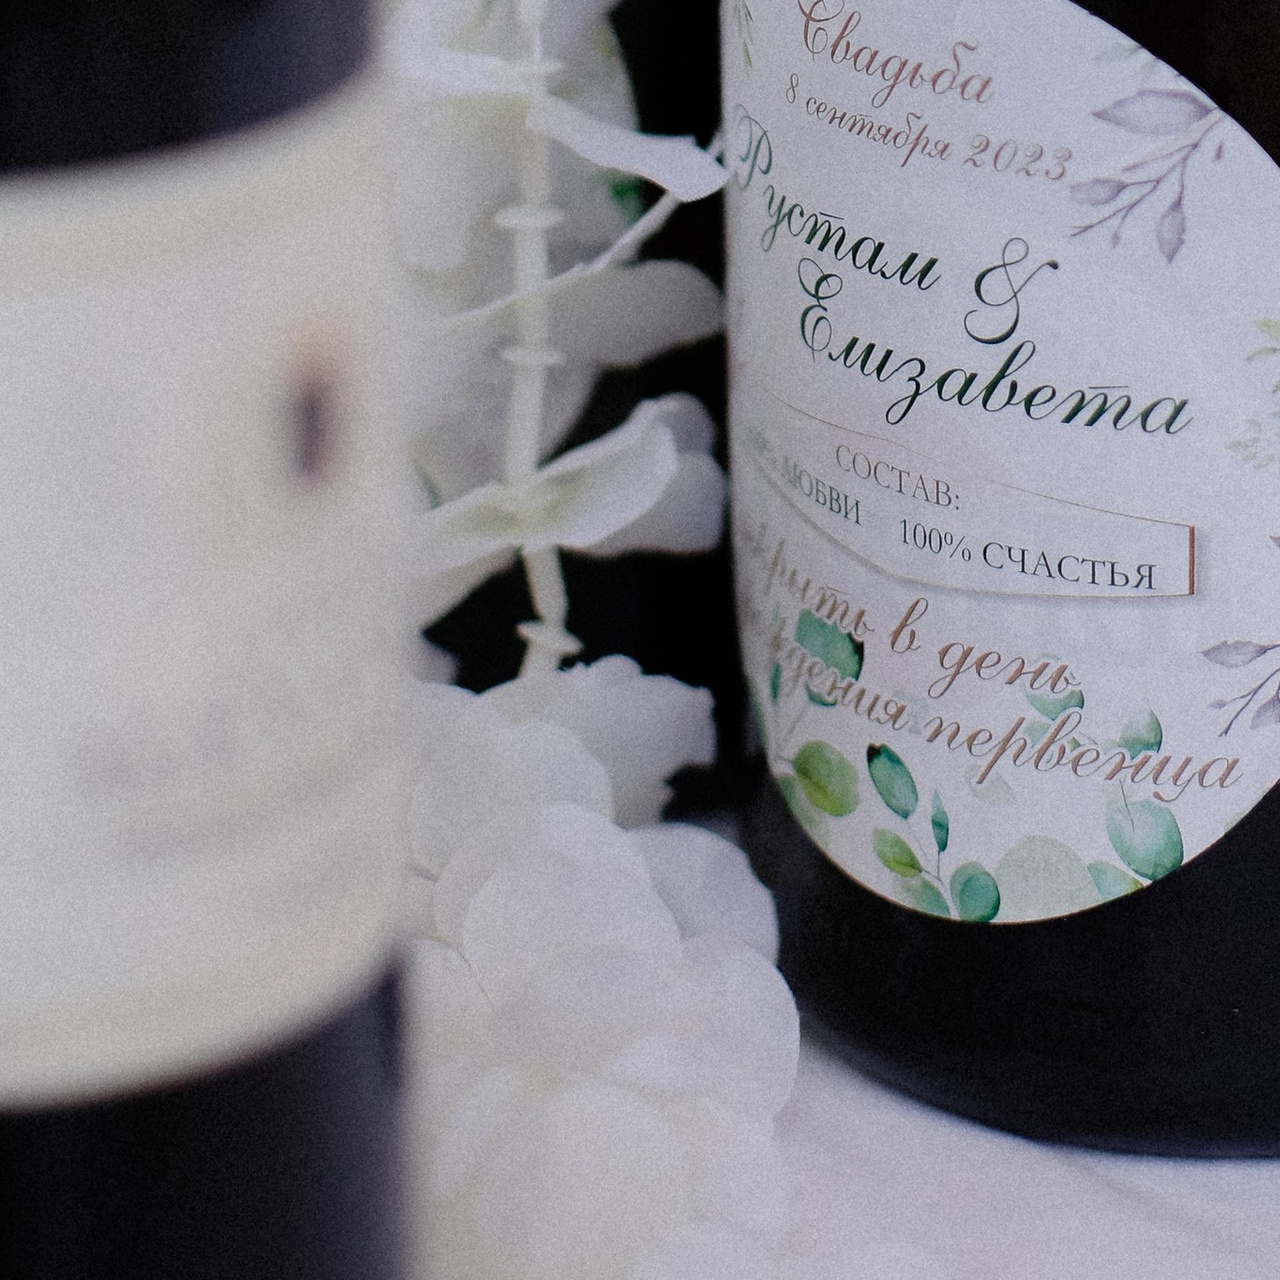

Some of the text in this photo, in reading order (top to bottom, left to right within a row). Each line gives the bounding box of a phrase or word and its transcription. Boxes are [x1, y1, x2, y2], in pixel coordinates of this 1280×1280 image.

[785, 72, 1073, 181] 8 сентября 2023
[734, 103, 1059, 345] Рустам &
[797, 257, 1196, 436] Елизавета
[835, 444, 960, 511] СОСТАВ:
[899, 517, 972, 563] 100%
[981, 541, 1158, 591] СЧАСТЬЯ
[889, 596, 929, 654] в
[927, 636, 1083, 698] день
[923, 707, 1245, 803] первенца
